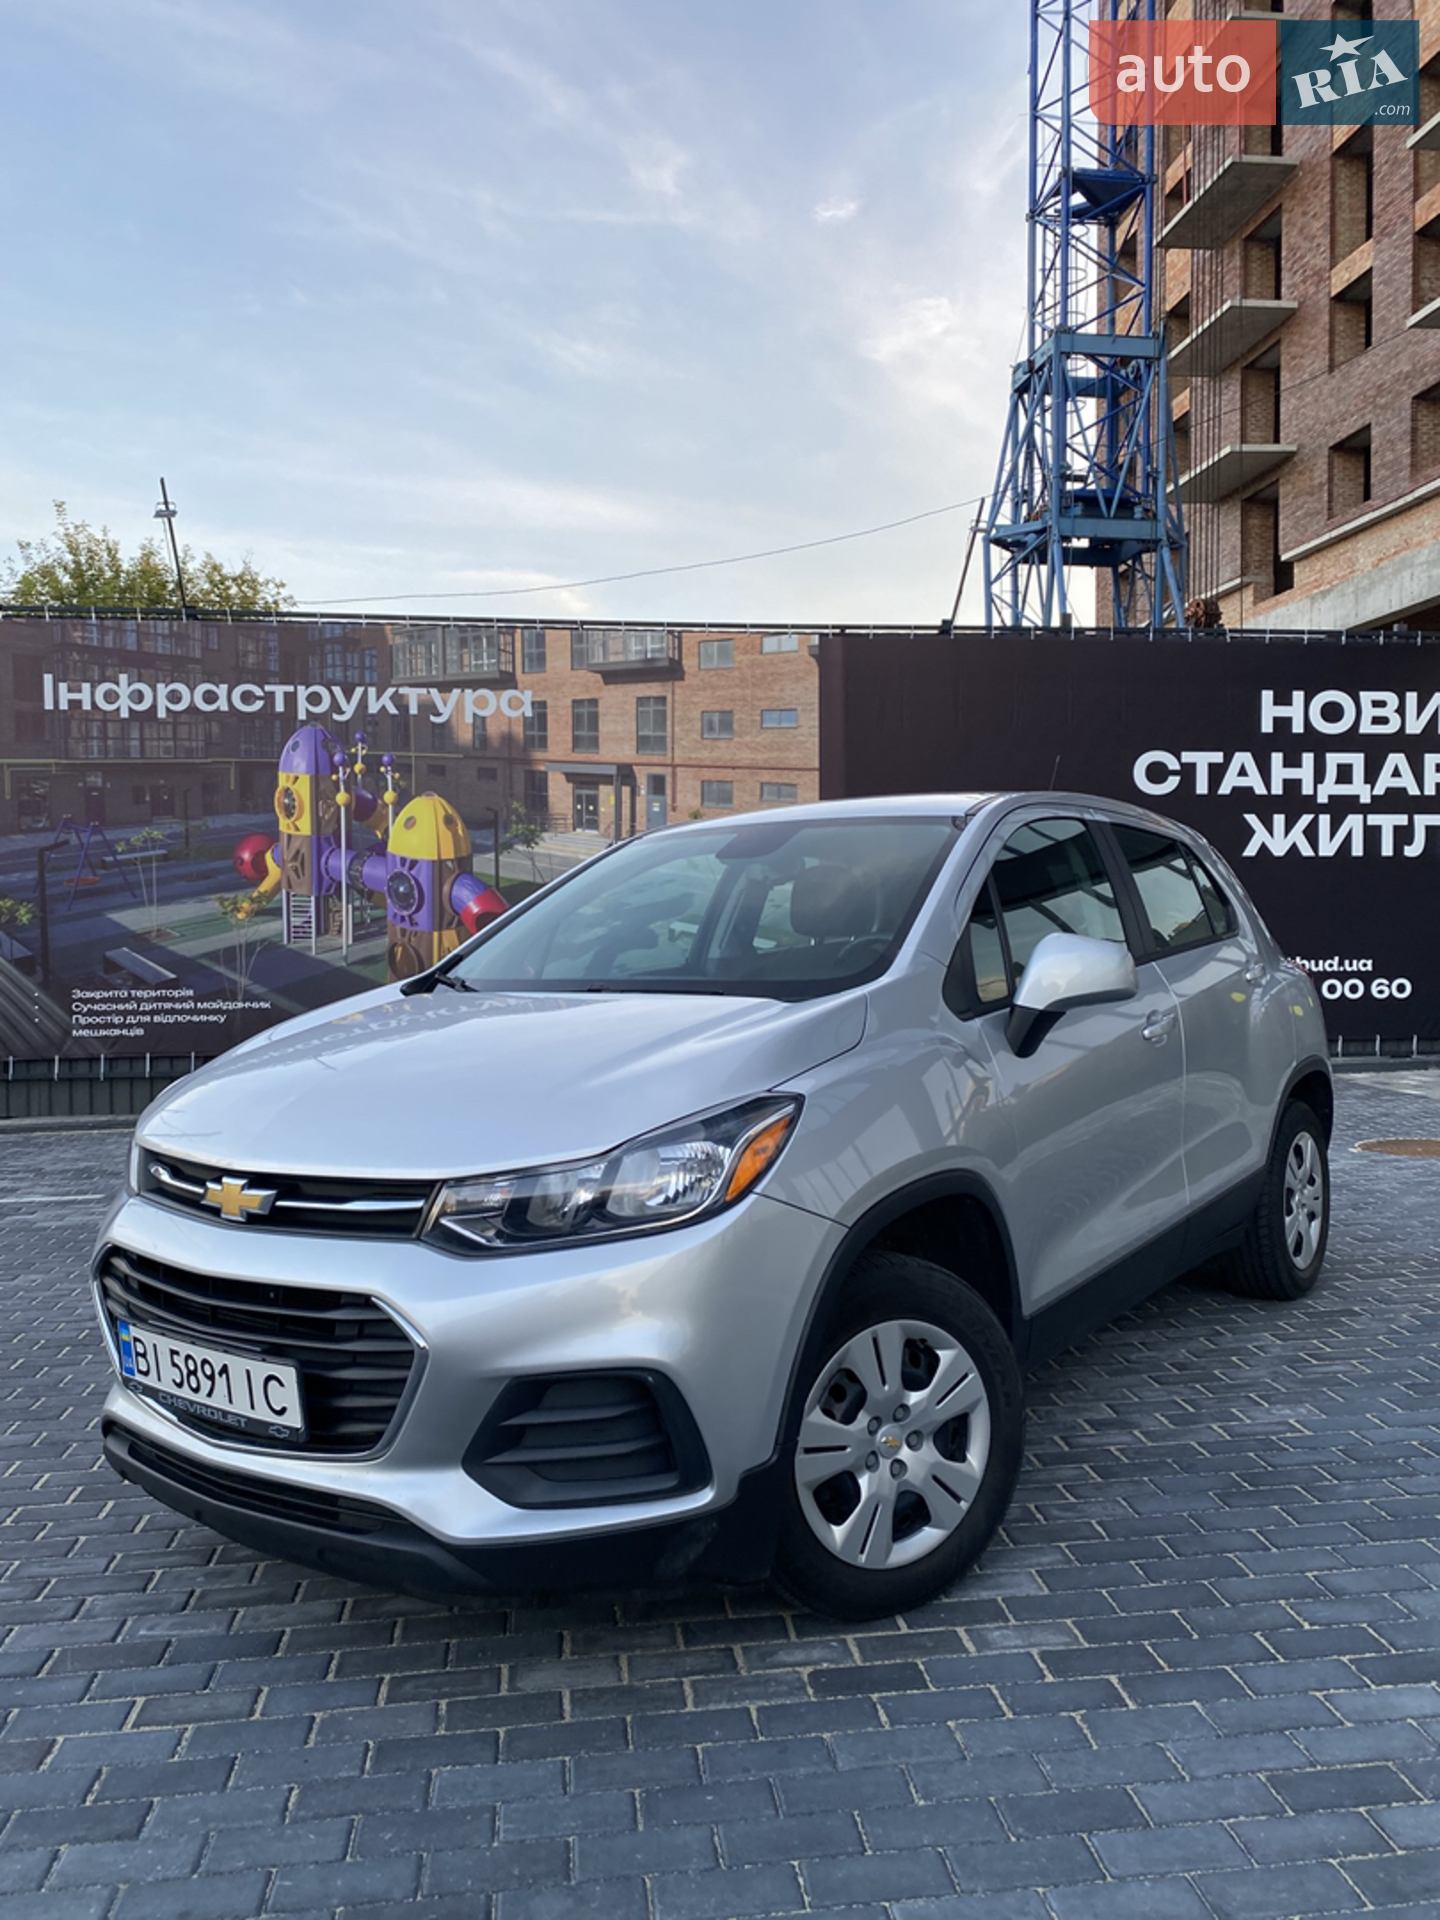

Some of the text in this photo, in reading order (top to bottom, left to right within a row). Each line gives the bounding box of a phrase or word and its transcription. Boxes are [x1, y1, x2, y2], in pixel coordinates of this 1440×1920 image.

[43, 673, 534, 724] Інфраструктура
[71, 986, 194, 999] Закрита територія
[1321, 977, 1413, 1000] 00 60
[71, 1000, 271, 1013] Сучасний дитячий майданчик
[72, 1012, 227, 1025] Простір для відпочинку
[72, 1026, 144, 1037] мешканців
[133, 1336, 288, 1417] BI 5891 IC
[158, 1392, 248, 1428] CHEVROLET
